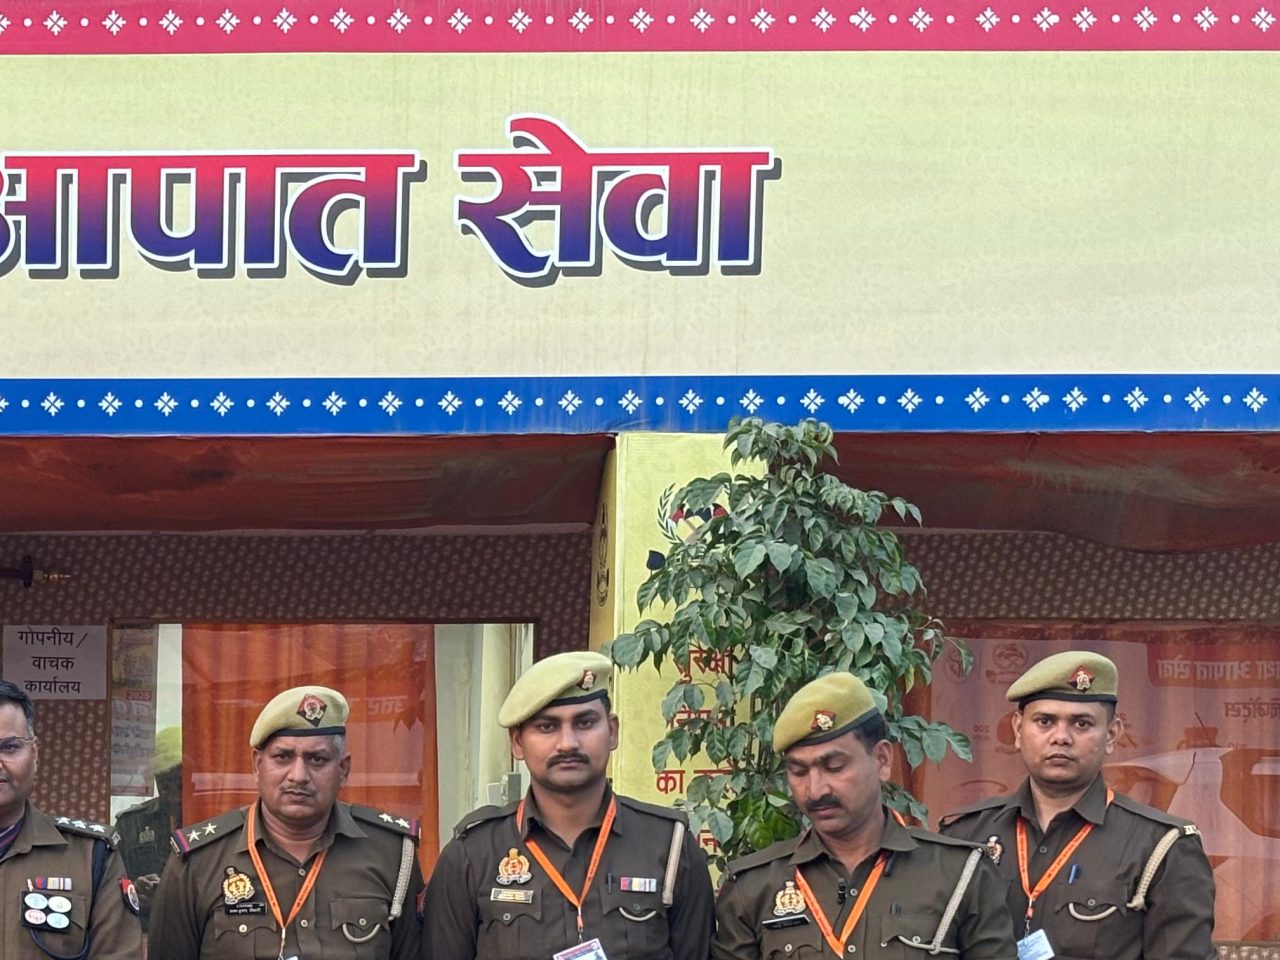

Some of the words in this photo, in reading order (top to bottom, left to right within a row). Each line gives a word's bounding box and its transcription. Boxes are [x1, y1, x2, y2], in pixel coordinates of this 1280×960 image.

[457, 116, 772, 278] सेवा
[31, 655, 75, 671] वाचक
[24, 676, 81, 694] कार्यालय
[655, 769, 686, 794] का
